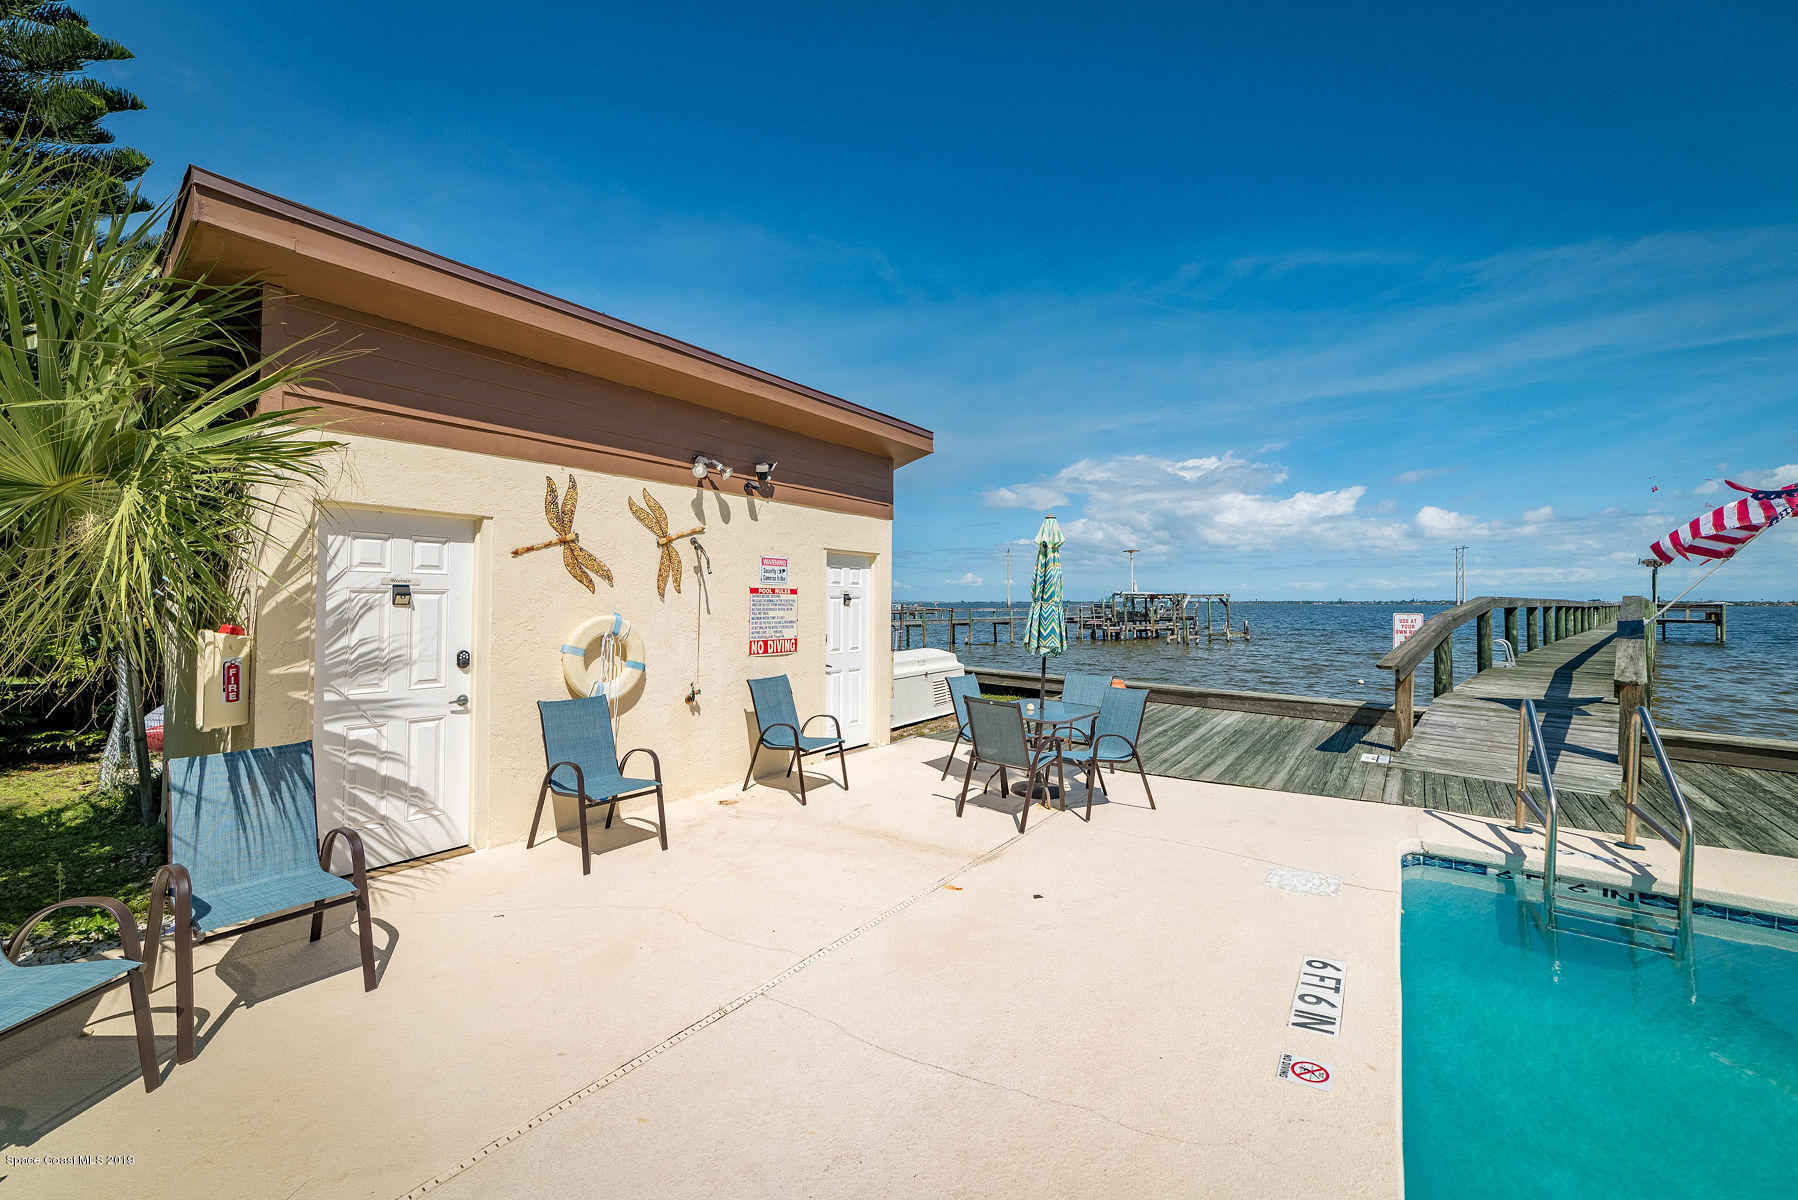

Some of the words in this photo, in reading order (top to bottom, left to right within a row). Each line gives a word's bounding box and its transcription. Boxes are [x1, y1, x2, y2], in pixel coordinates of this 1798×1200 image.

[751, 641, 764, 654] NO
[768, 639, 795, 653] DIVING
[228, 668, 237, 700] FIRE
[1568, 883, 1588, 893] 6
[1602, 888, 1635, 902] IN
[1305, 960, 1342, 971] 6
[1301, 972, 1342, 994] FT
[1297, 993, 1338, 1008] 6
[1291, 1009, 1336, 1035] IN
[1283, 1053, 1292, 1061] NO
